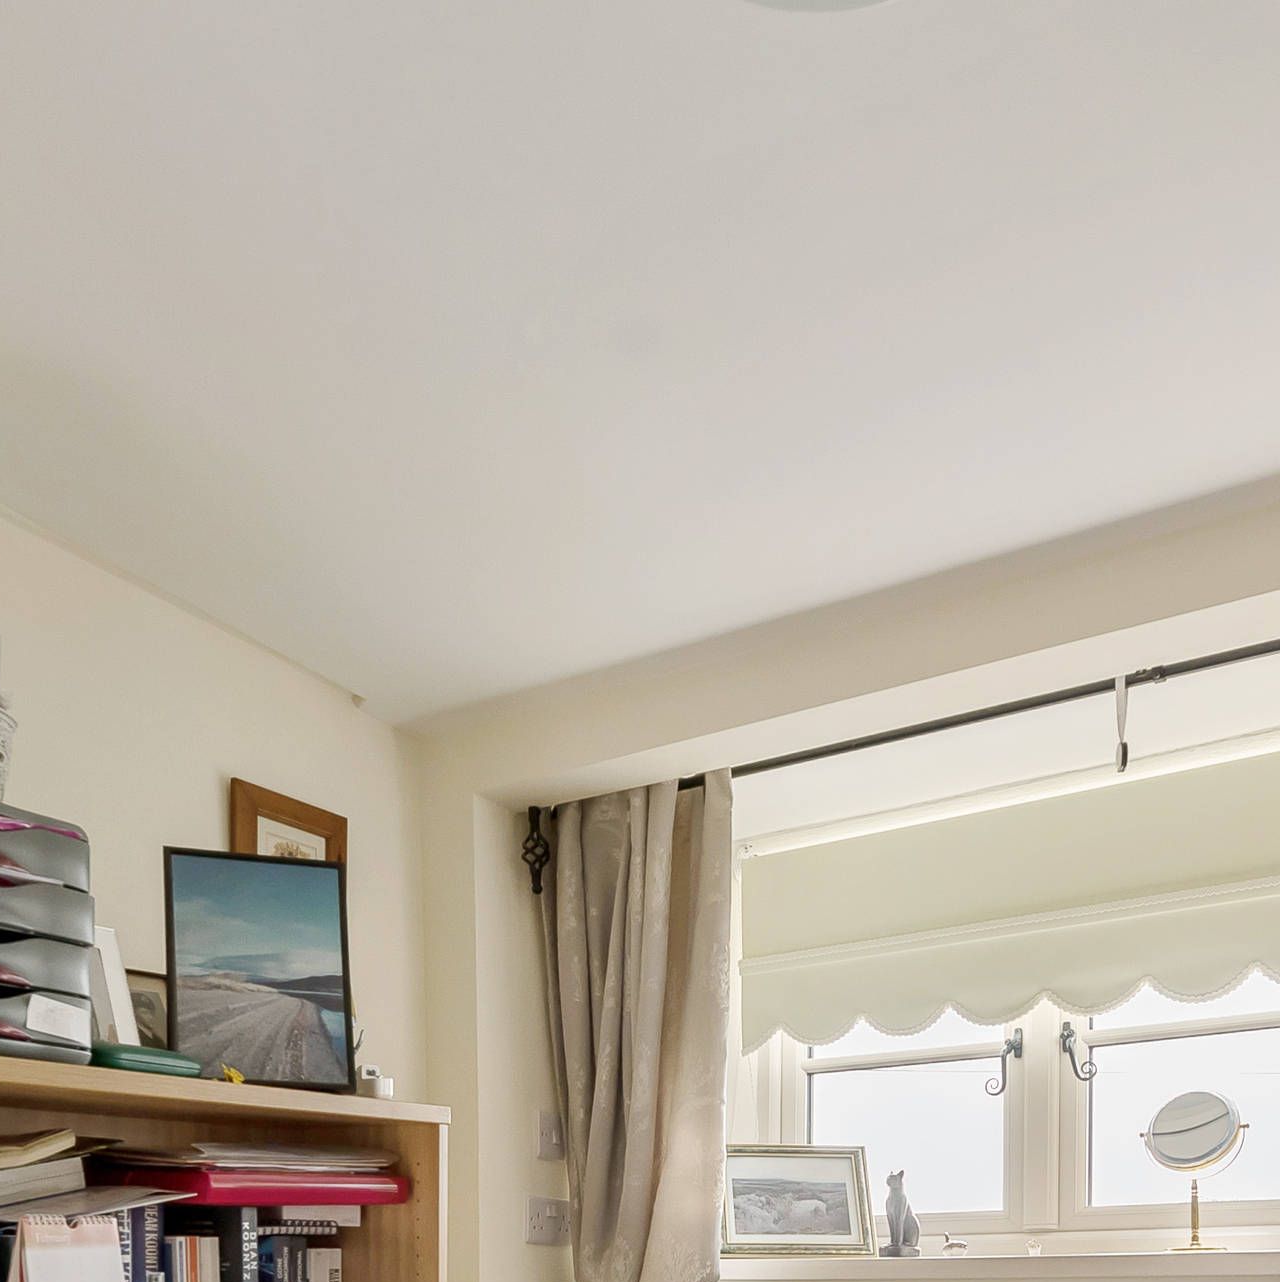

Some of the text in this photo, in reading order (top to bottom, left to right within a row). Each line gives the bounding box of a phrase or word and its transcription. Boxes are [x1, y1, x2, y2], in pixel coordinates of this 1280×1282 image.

[144, 1236, 158, 1272] KOONT
[242, 1222, 251, 1280] KOONTZ
[250, 1232, 258, 1270] DEAN
